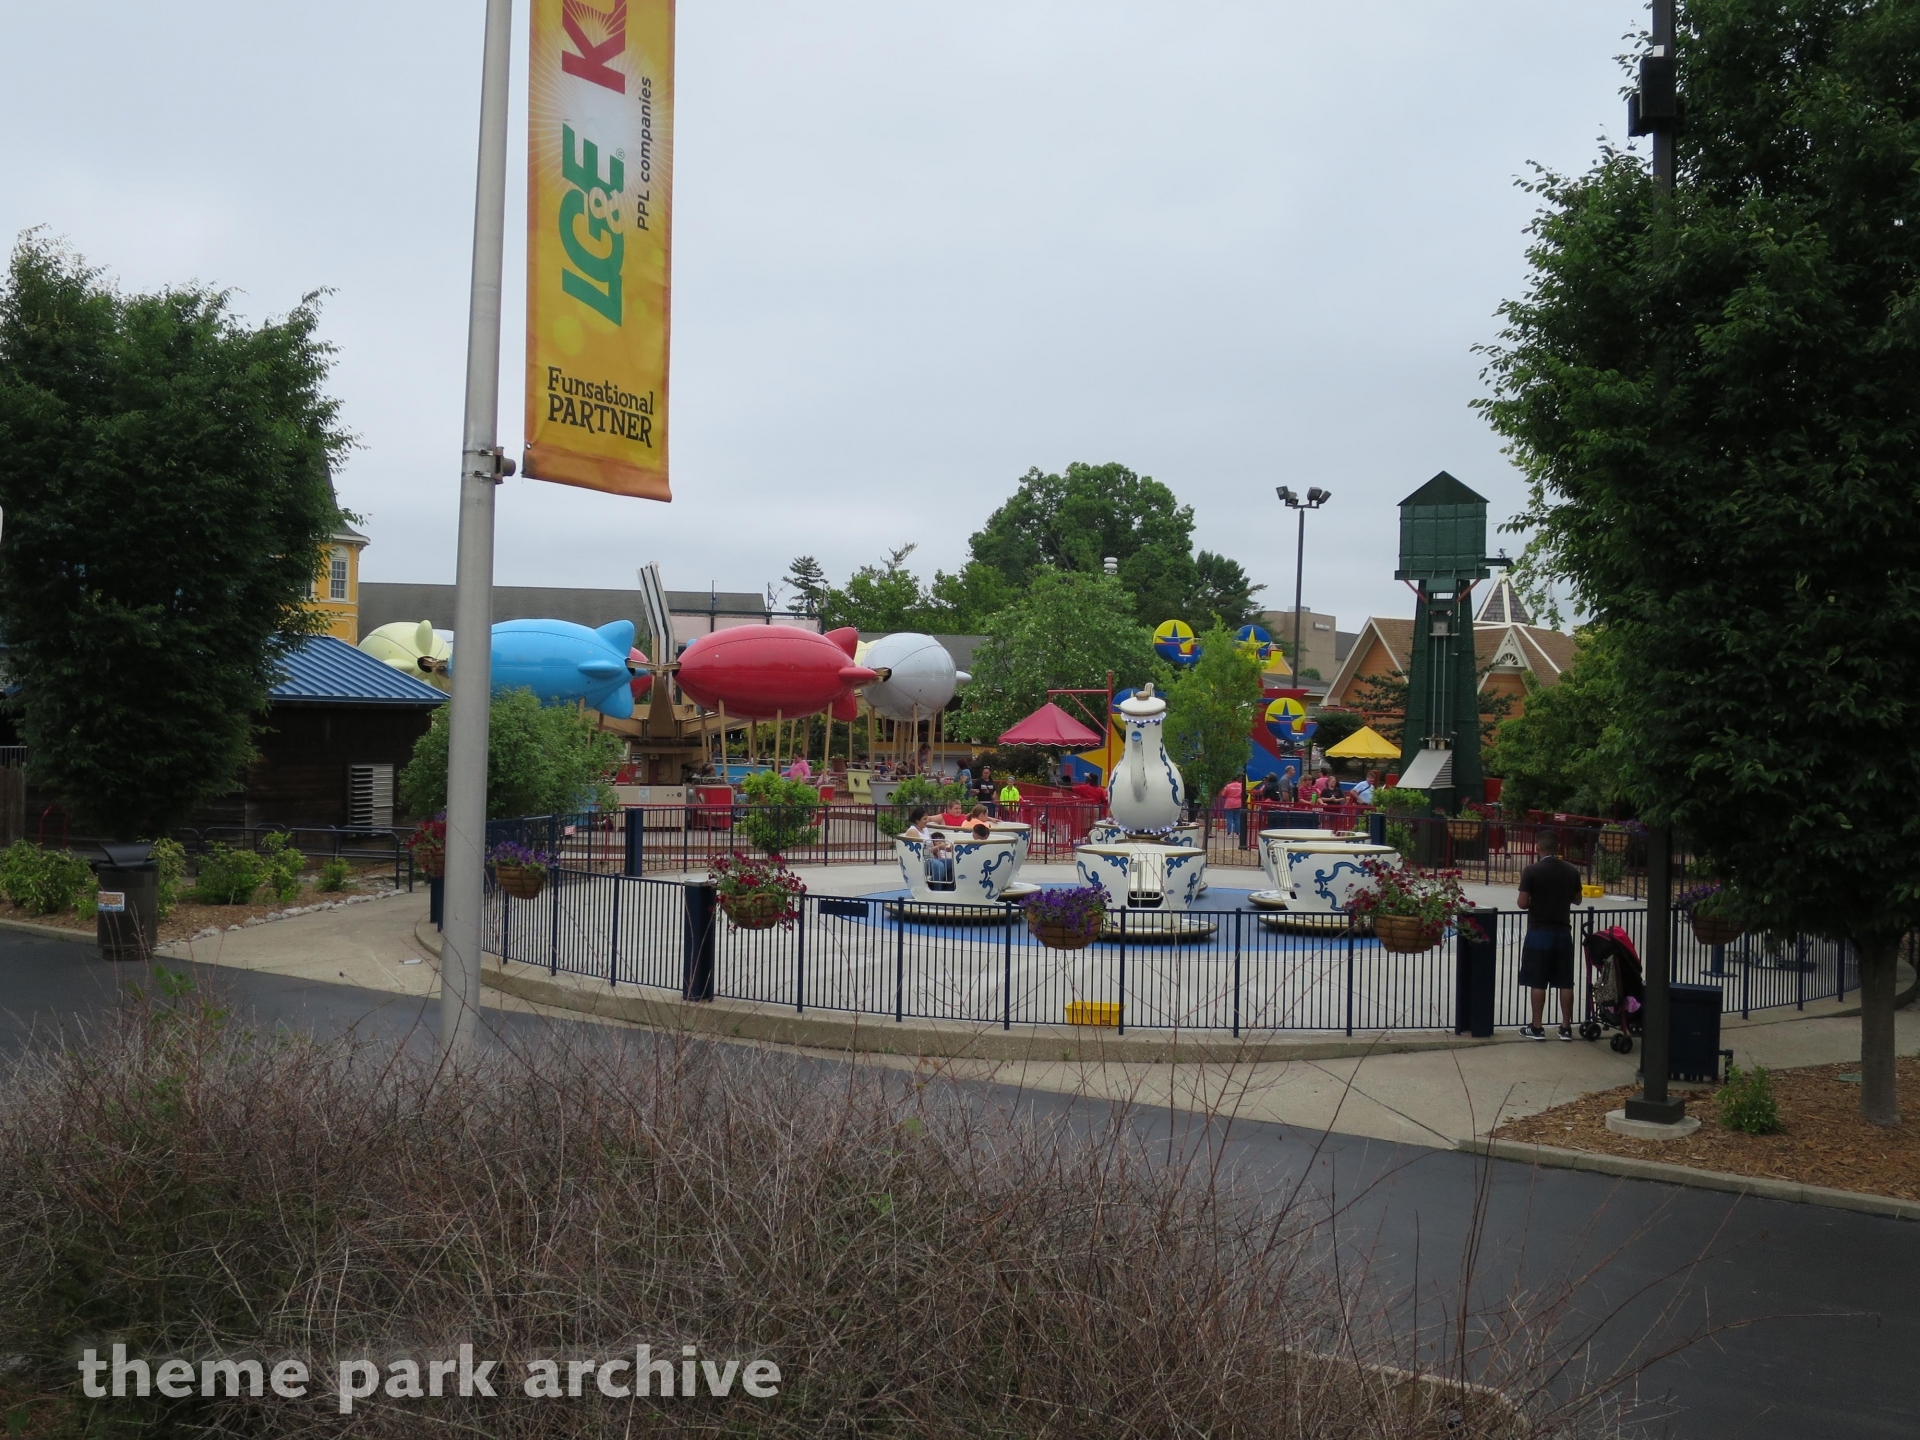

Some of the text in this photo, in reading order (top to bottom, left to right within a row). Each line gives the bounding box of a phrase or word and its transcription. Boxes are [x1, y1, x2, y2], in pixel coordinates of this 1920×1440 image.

[637, 76, 652, 231] PPL companies
[547, 366, 654, 415] Funsational
[548, 394, 652, 448] PARTNER
